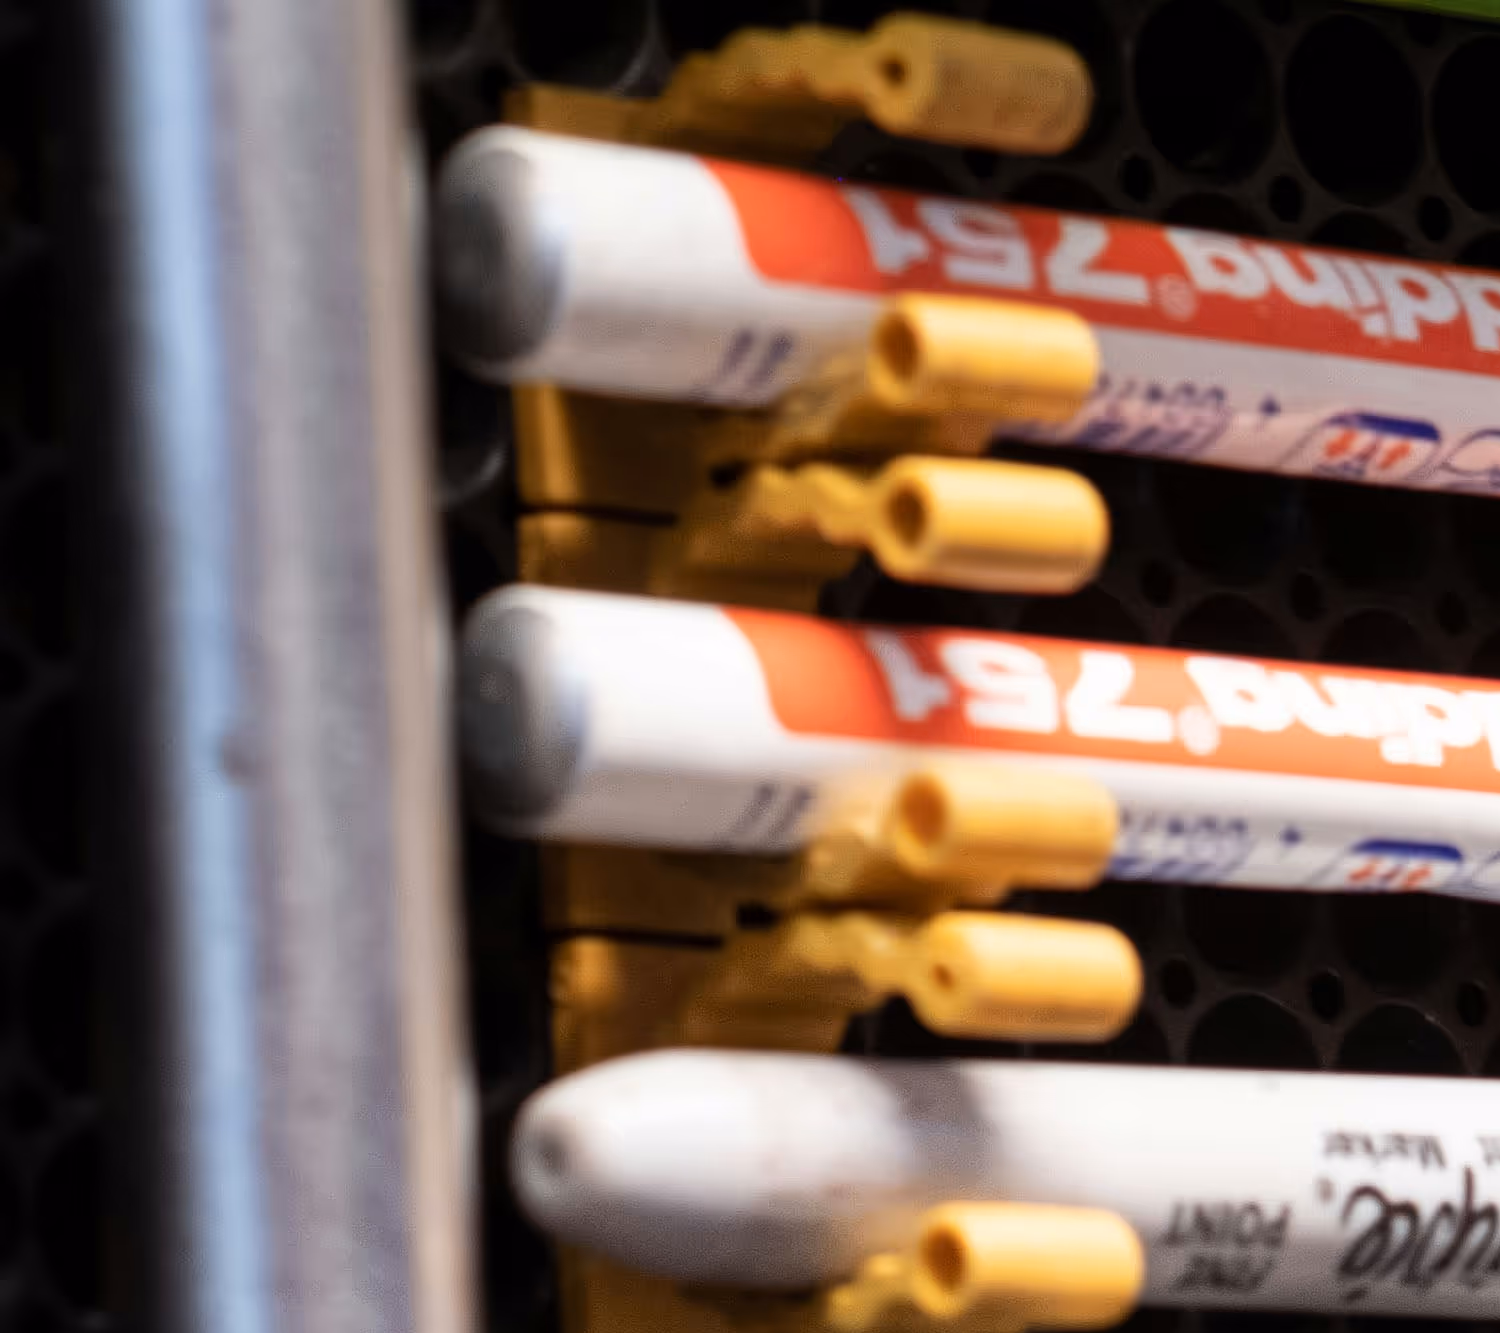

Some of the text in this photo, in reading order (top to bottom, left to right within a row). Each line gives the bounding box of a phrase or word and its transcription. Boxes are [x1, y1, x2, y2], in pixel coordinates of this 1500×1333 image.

[842, 188, 1150, 307] 751
[864, 630, 1174, 743] 751
[1320, 1129, 1449, 1170] Marker
